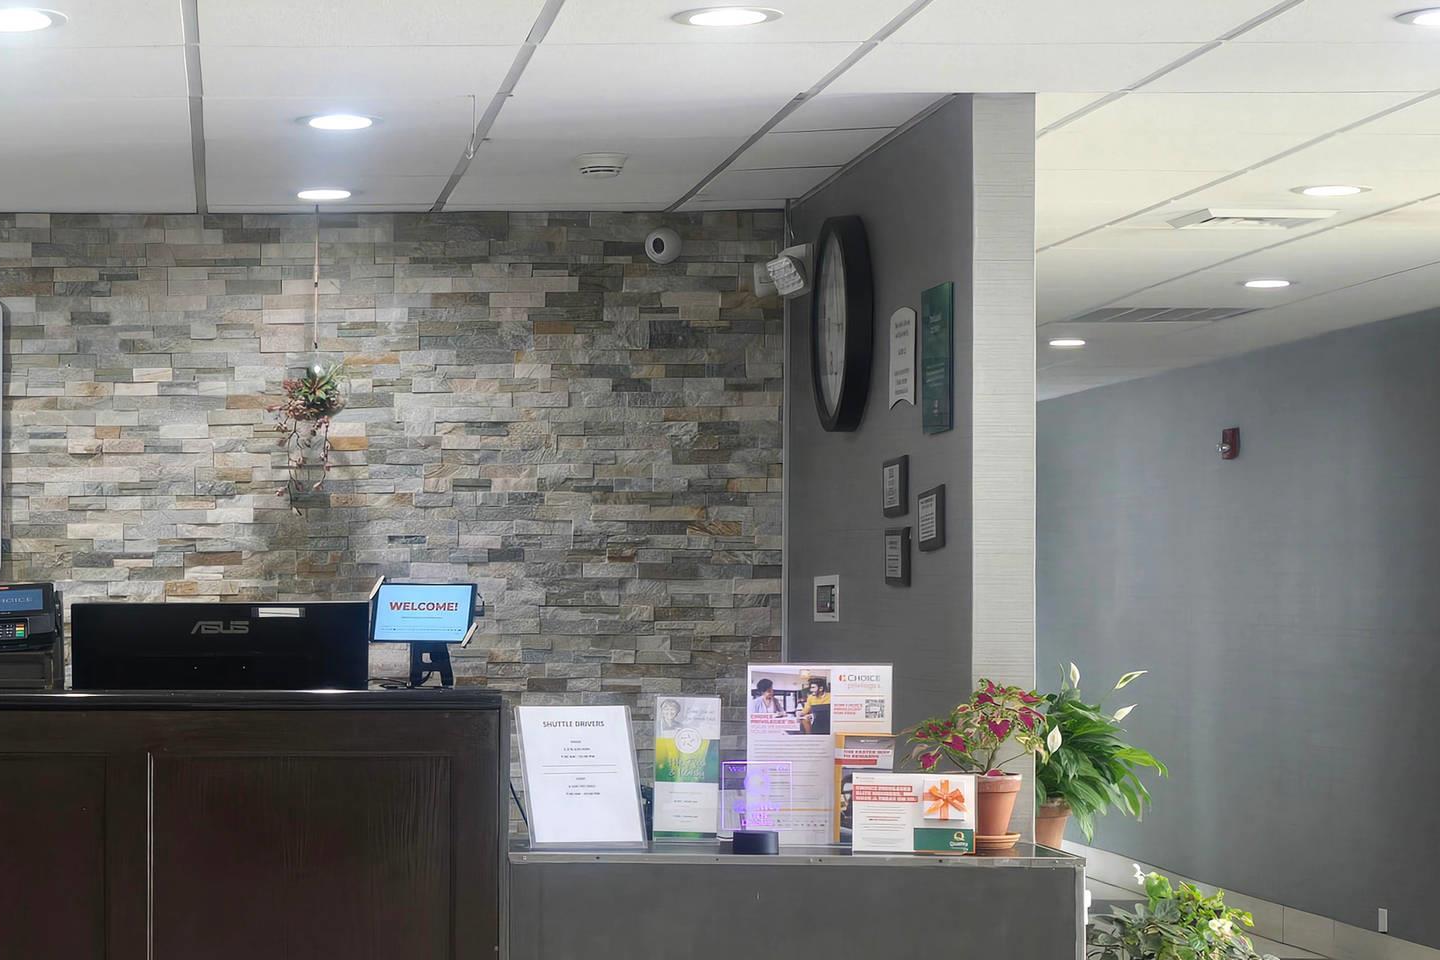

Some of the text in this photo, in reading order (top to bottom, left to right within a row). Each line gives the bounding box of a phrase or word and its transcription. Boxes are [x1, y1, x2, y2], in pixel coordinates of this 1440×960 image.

[389, 602, 459, 612] WELCOME!
[191, 621, 250, 634] ASUS
[847, 674, 881, 682] CHOICE
